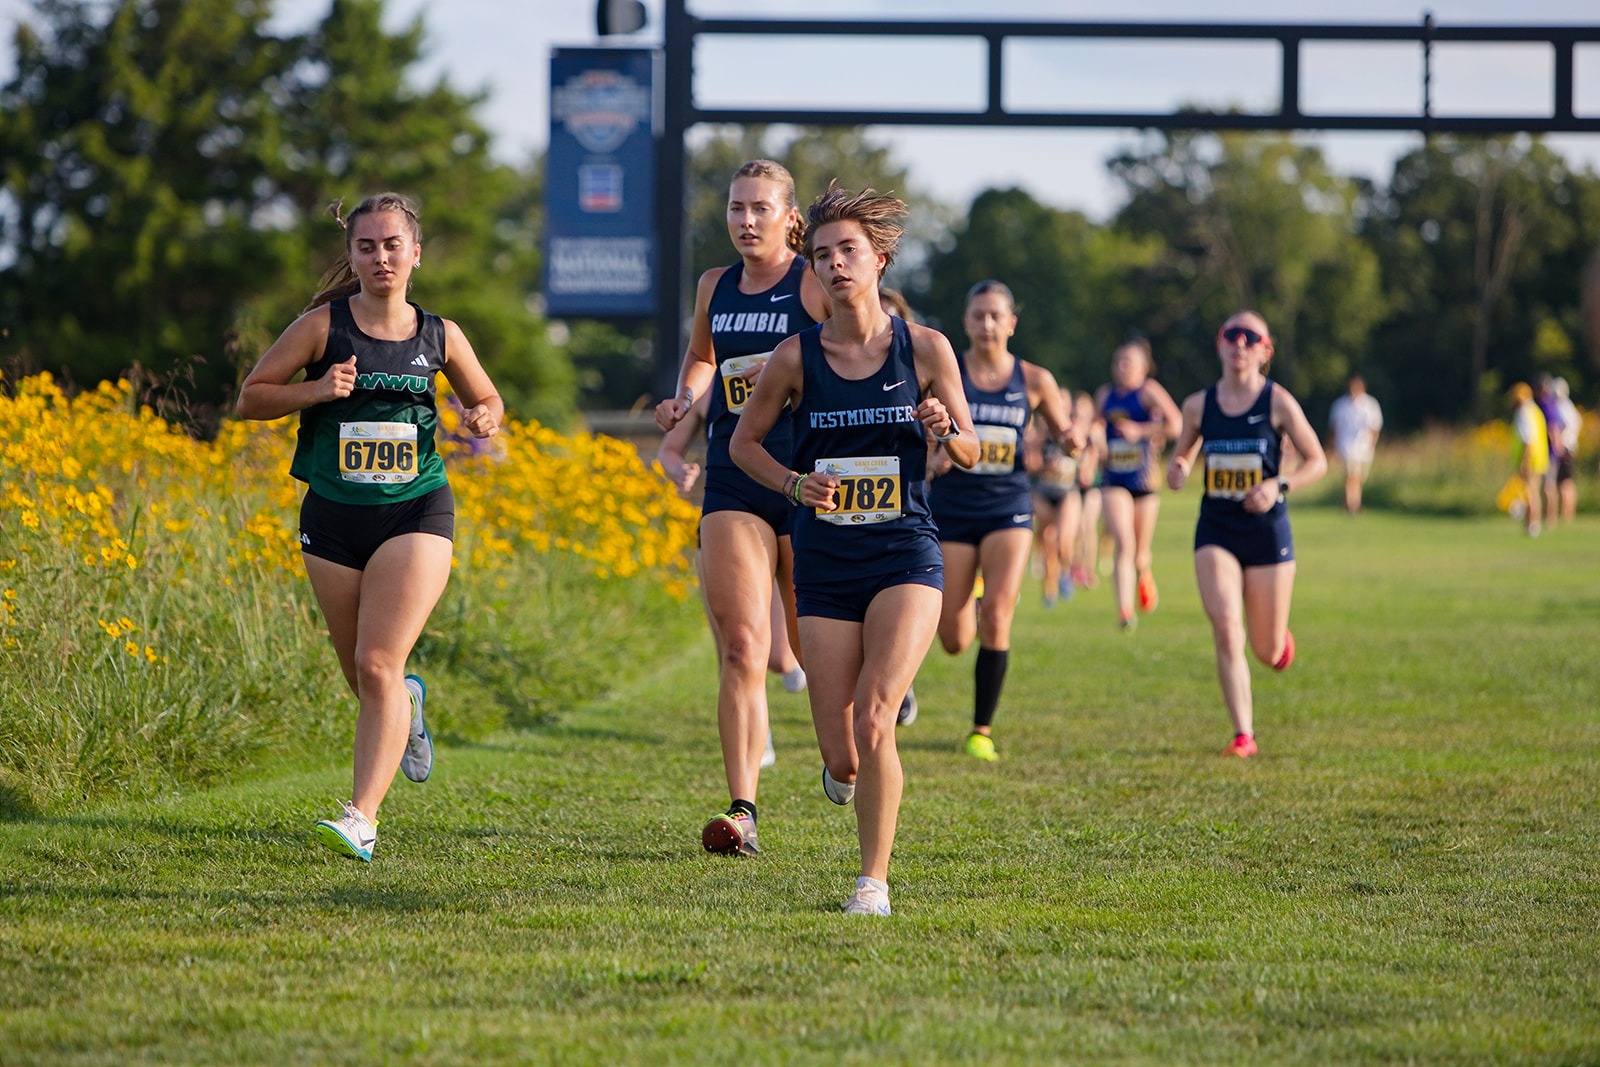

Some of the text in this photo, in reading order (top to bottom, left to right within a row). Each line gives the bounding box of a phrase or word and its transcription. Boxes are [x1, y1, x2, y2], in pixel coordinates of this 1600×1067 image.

[711, 312, 789, 334] COLUMBIA
[354, 372, 428, 394] WWU
[809, 405, 915, 428] WESTMINSTER
[345, 441, 413, 471] 6796
[1214, 470, 1256, 489] 6781
